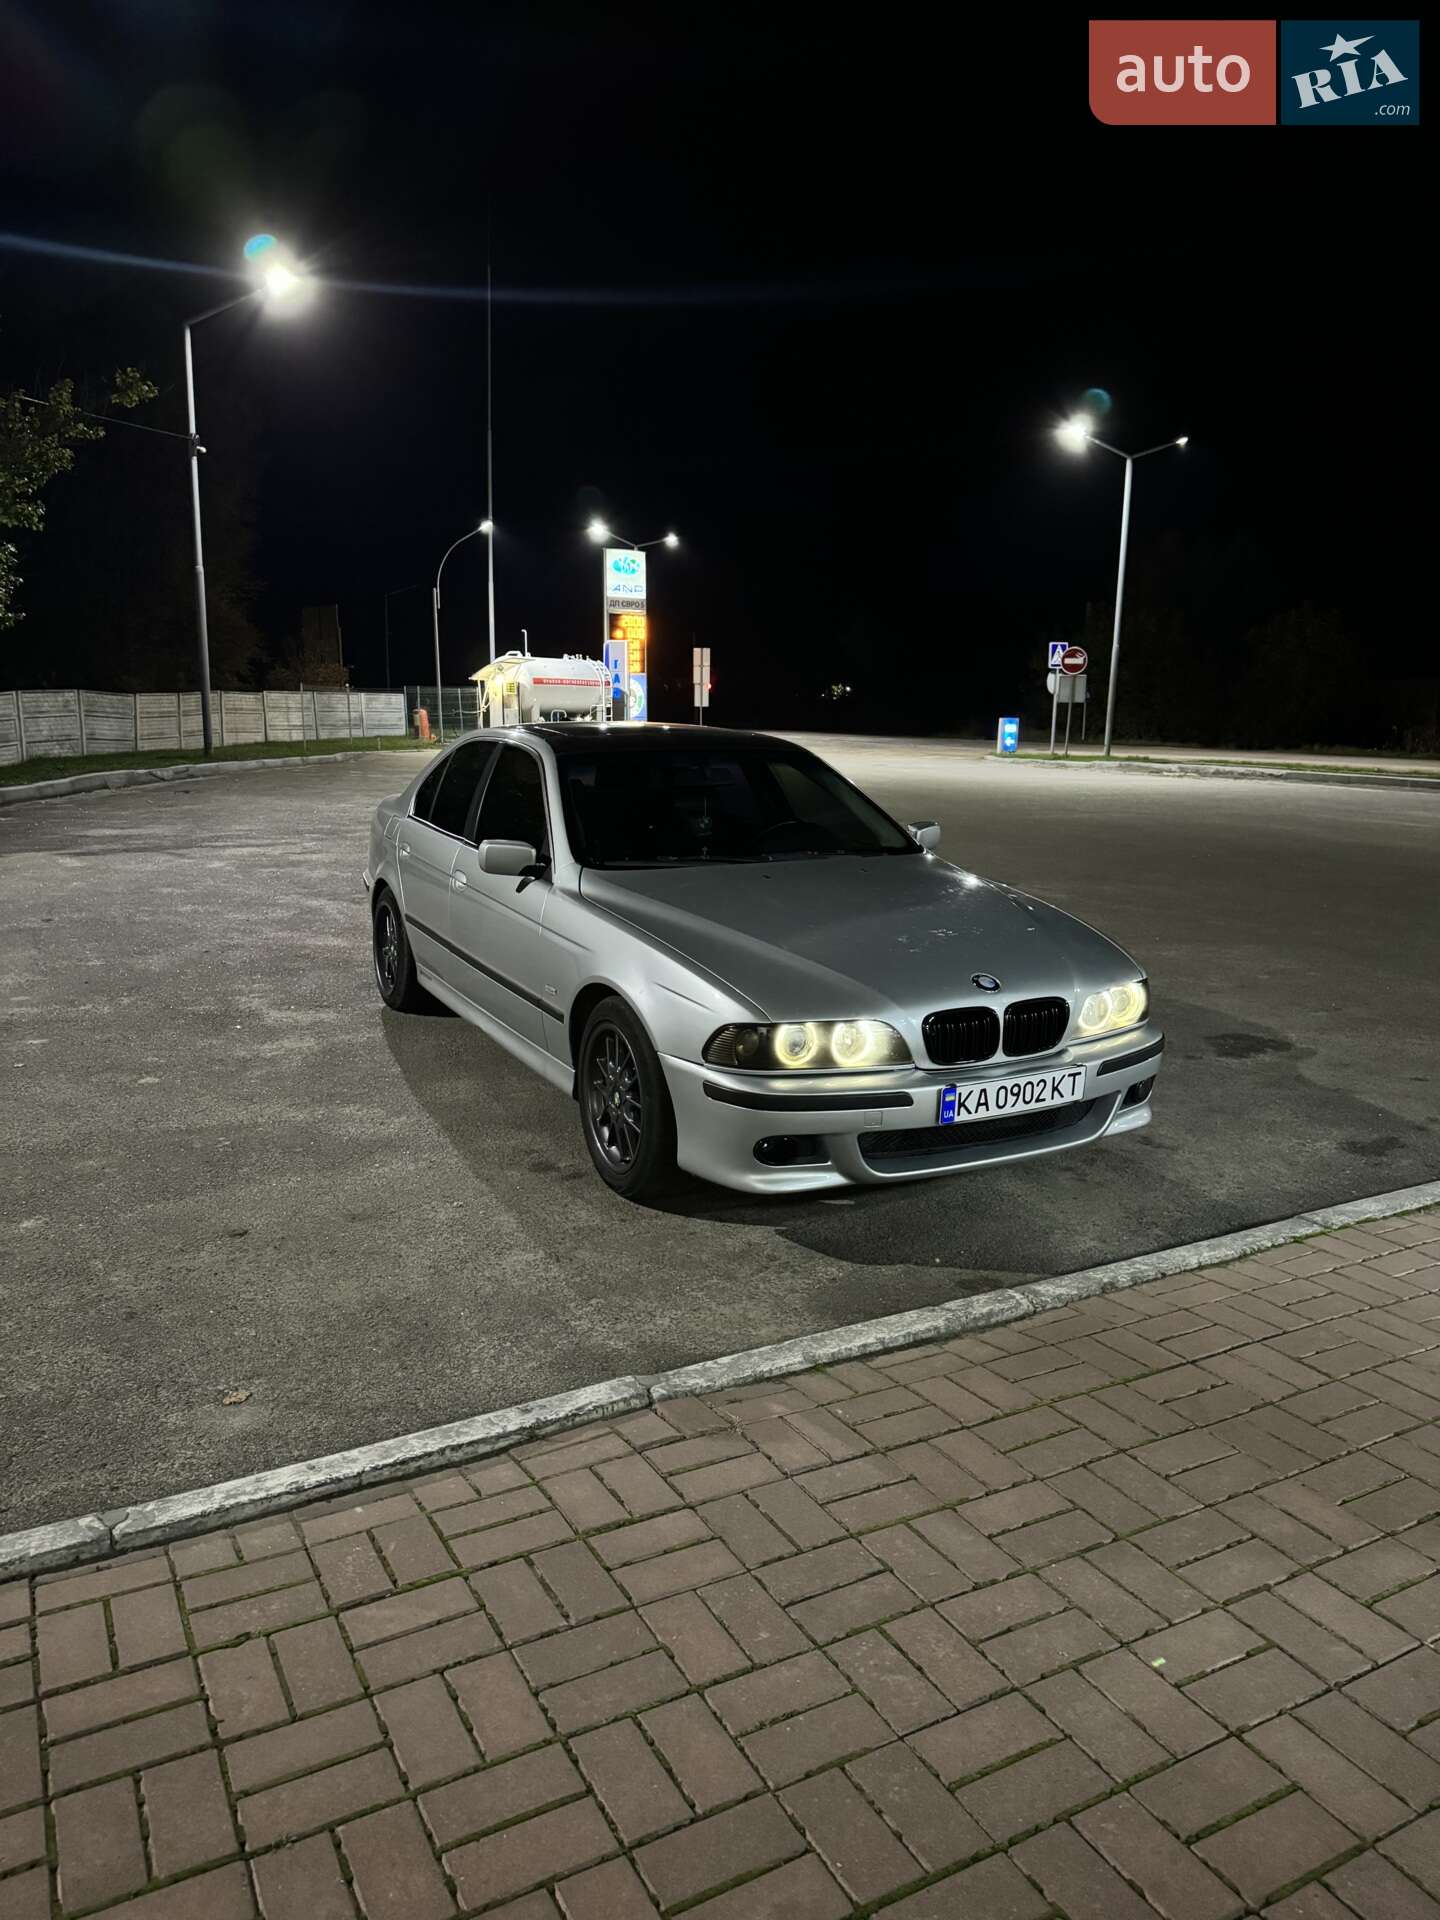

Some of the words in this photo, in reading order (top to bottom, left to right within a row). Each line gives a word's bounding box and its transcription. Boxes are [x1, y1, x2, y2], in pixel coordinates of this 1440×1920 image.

[957, 1088, 990, 1117] KA
[995, 1078, 1047, 1110] 0902
[1051, 1071, 1082, 1101] KT
[943, 1110, 954, 1119] UA
